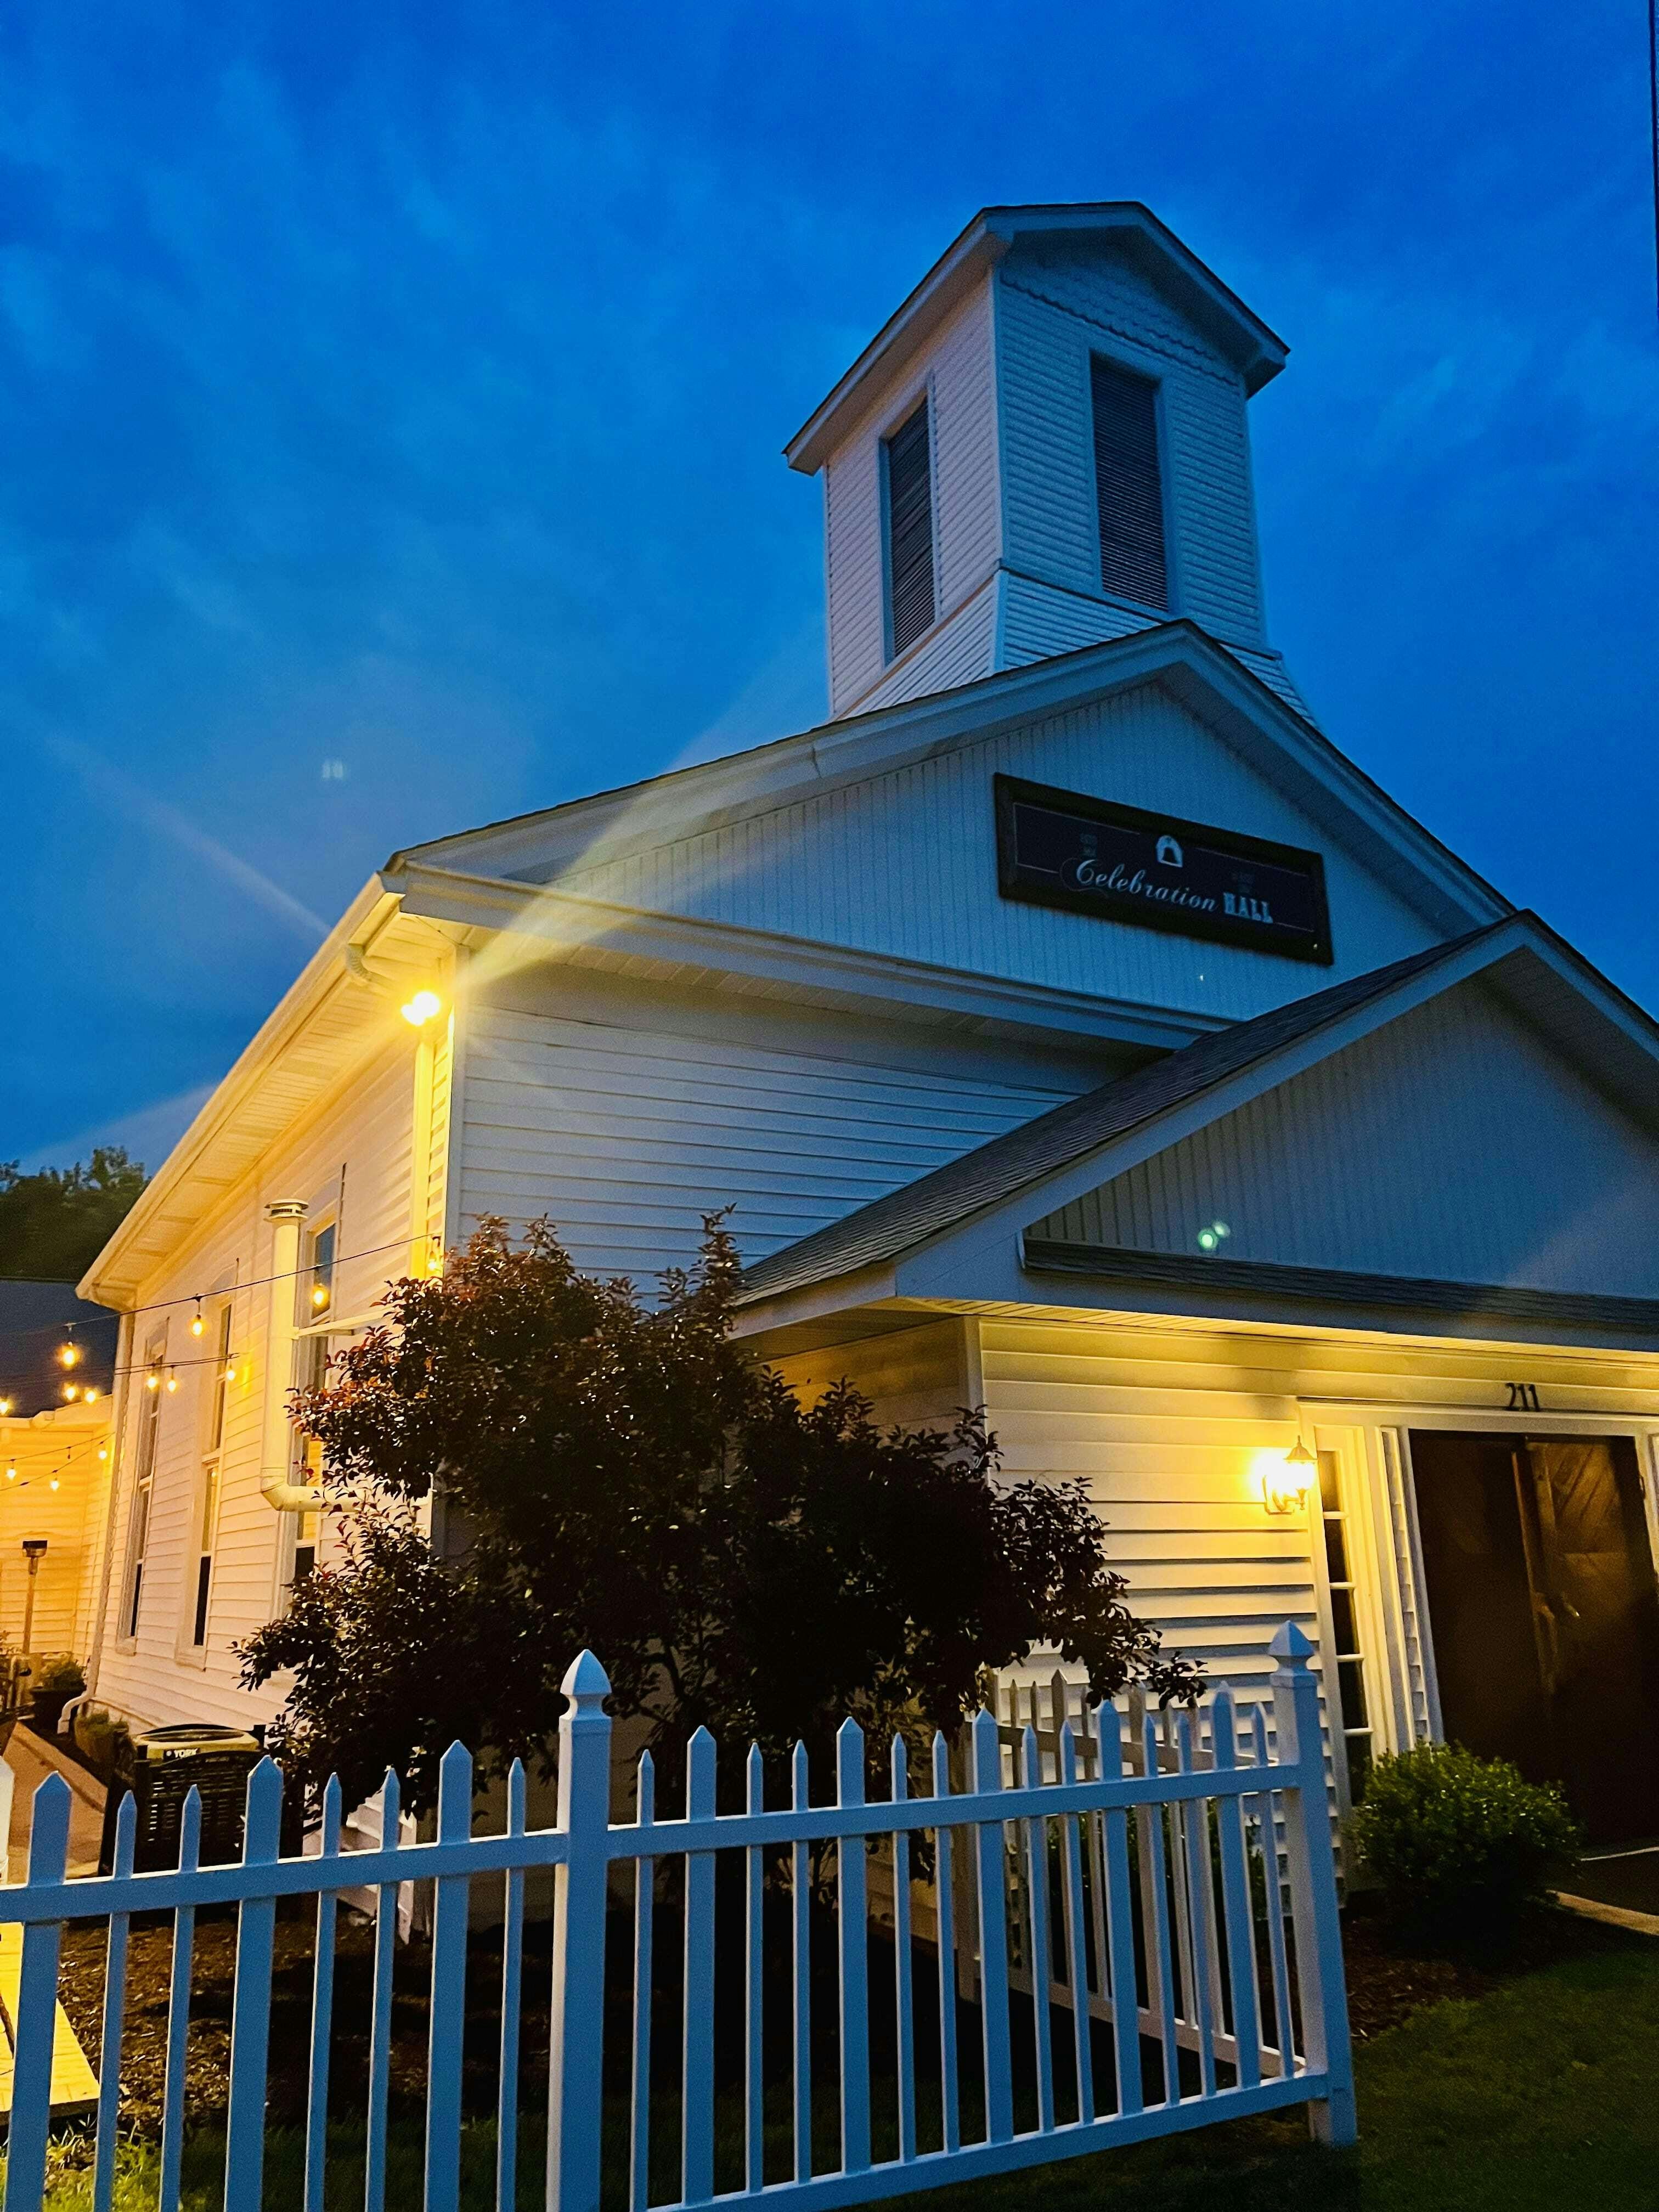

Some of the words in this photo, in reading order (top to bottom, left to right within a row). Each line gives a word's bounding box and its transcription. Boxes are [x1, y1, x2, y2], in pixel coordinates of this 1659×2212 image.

[1076, 859, 1218, 912] Celebration
[1223, 891, 1273, 924] HALL
[1505, 1382, 1540, 1412] 211
